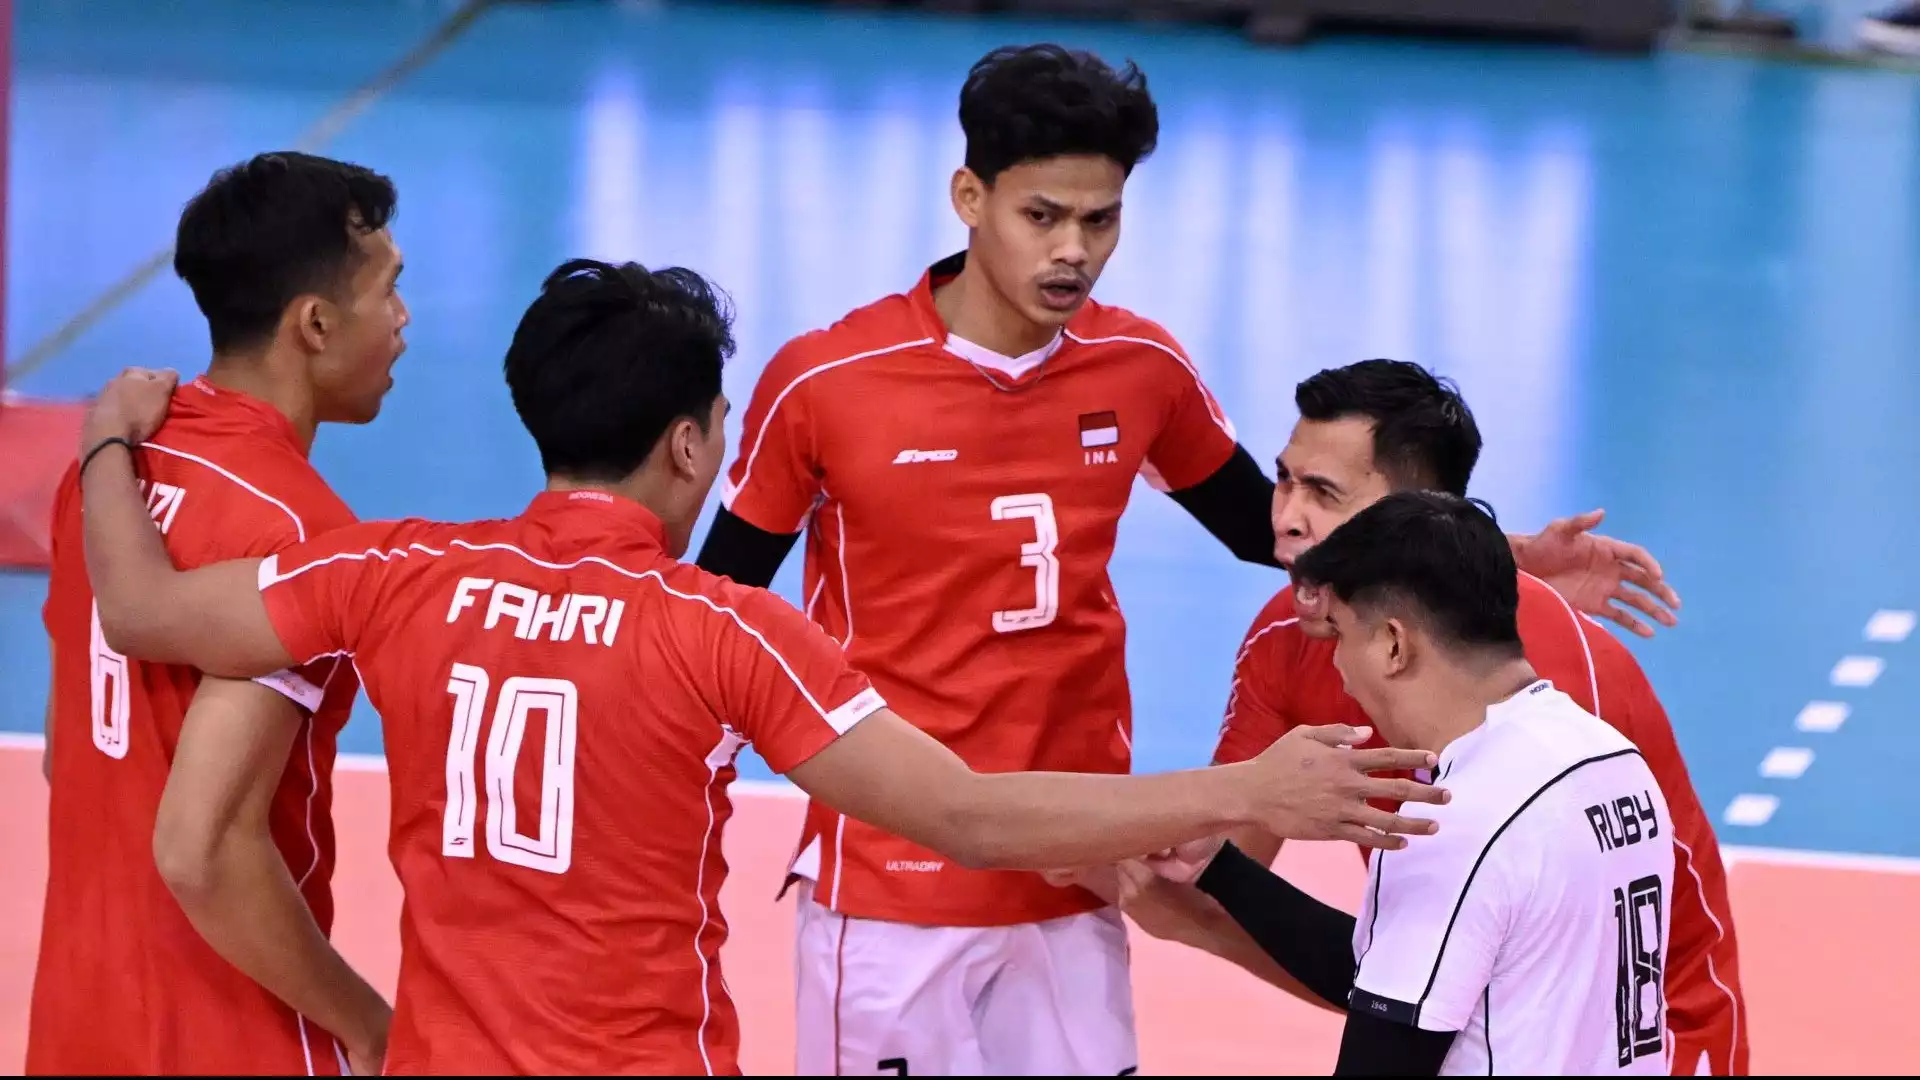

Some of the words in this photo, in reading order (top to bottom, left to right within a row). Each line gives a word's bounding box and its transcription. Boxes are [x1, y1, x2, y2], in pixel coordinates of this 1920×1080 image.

[1084, 450, 1118, 465] INA
[447, 577, 625, 646] FAHRI
[991, 493, 1059, 633] 3
[442, 662, 578, 874] 10
[1584, 790, 1658, 853] RUBY
[1613, 874, 1662, 1068] 18
